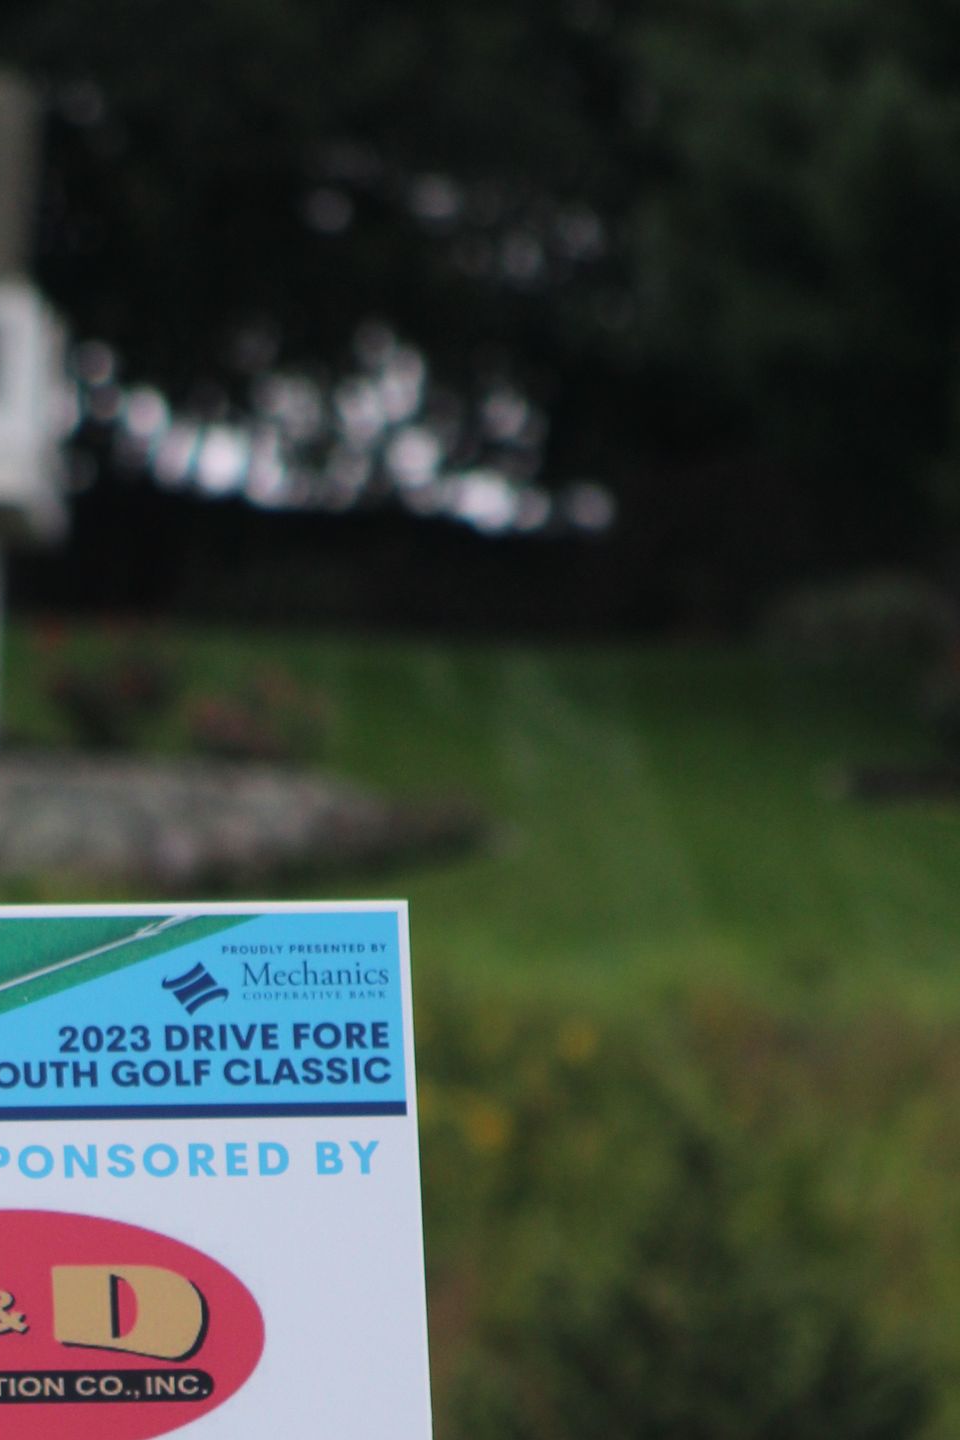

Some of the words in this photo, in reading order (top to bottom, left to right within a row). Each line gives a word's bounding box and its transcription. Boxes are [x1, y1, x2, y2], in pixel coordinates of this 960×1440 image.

[222, 944, 283, 955] PROUDLY
[289, 943, 365, 954] PRESENTED
[371, 943, 387, 953] BY
[243, 960, 389, 987] Mechanics
[243, 991, 341, 1001] COOPERATIVE
[349, 990, 386, 999] BANK
[58, 1024, 152, 1053] 2023
[165, 1022, 279, 1051] DRIVE
[293, 1021, 390, 1050] FORE
[111, 1058, 211, 1087] GOLF
[223, 1056, 392, 1086] CLASSIC
[315, 1141, 379, 1175] BY
[51, 1265, 209, 1362] D
[145, 1375, 208, 1395] INC.
